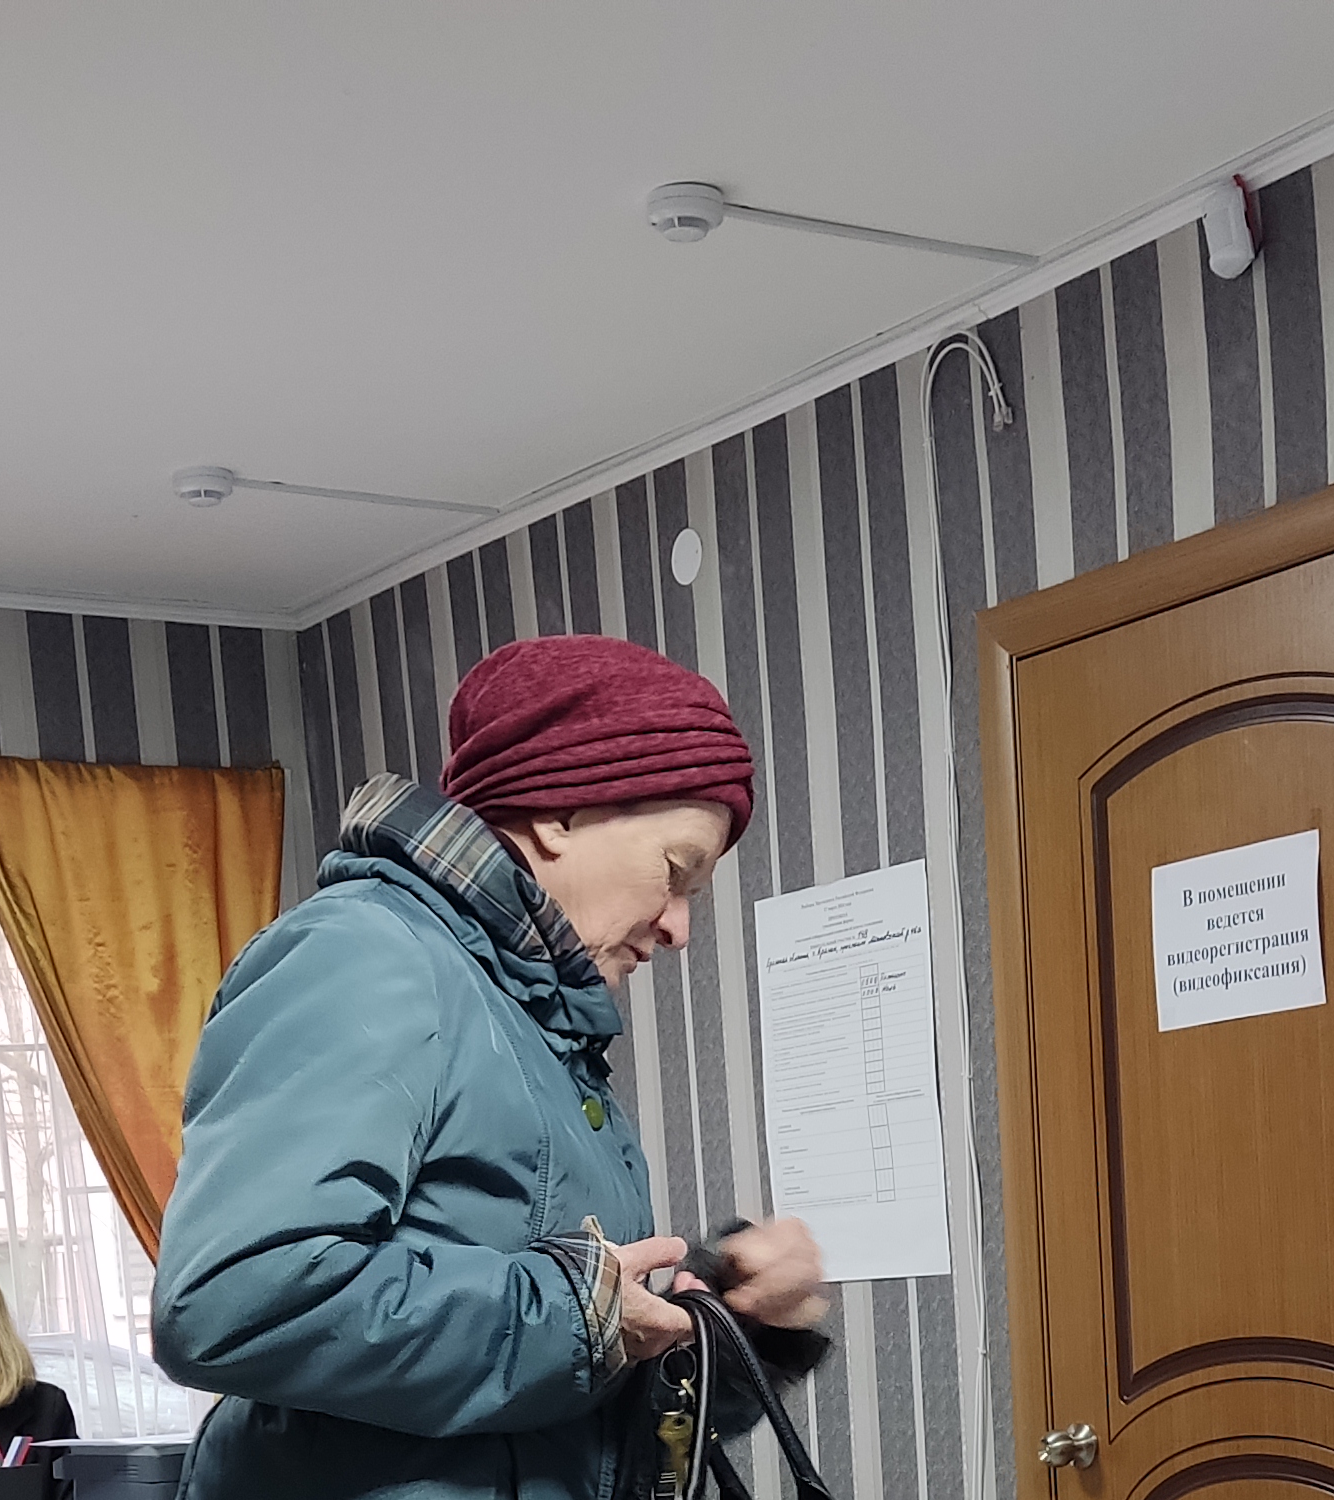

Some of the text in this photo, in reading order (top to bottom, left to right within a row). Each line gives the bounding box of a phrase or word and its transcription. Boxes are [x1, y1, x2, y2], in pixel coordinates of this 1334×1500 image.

[1183, 873, 1286, 908] В помещении
[1207, 907, 1265, 931] ведется
[1167, 928, 1309, 966] видеорегистрация
[1173, 955, 1307, 997] (видеофиксация)
